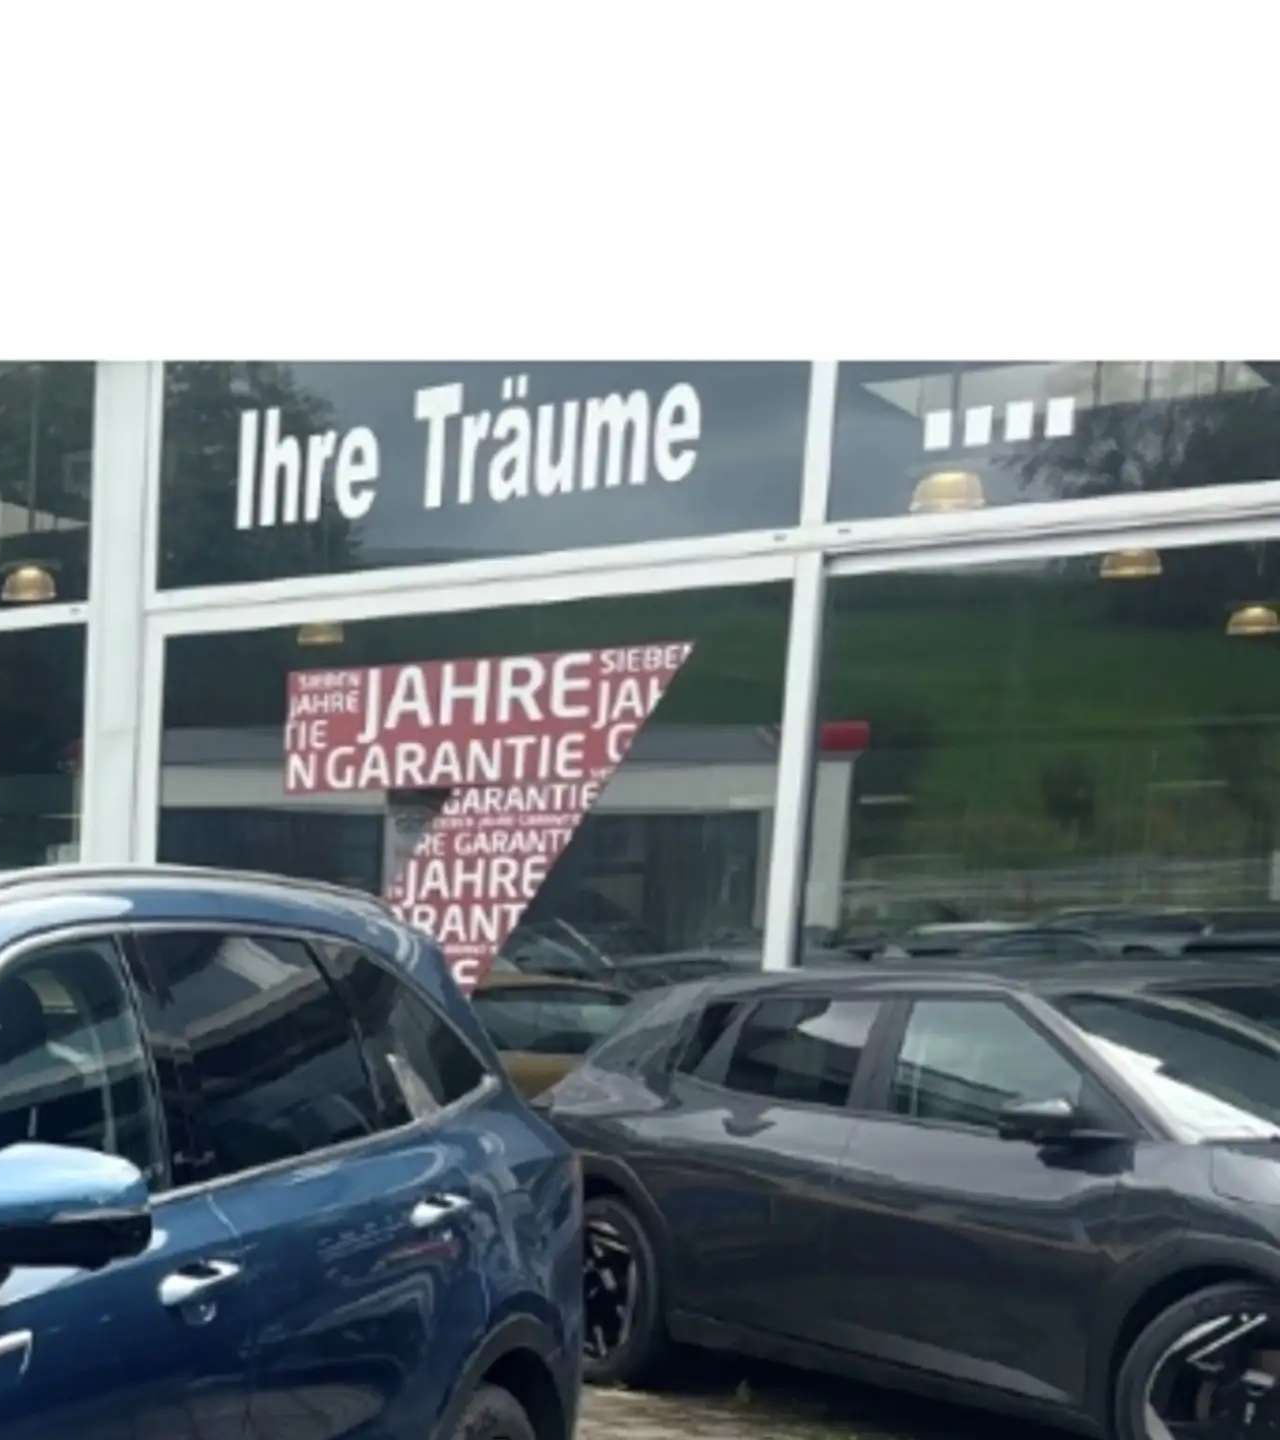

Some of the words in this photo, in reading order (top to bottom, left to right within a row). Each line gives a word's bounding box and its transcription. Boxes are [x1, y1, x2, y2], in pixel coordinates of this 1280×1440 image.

[236, 406, 380, 529] Ihre
[414, 374, 701, 509] Träume
[289, 691, 360, 718] JAHRE
[358, 653, 592, 744] JAHRE
[326, 733, 586, 790] GARANTIE
[401, 856, 548, 908] JAHRE
